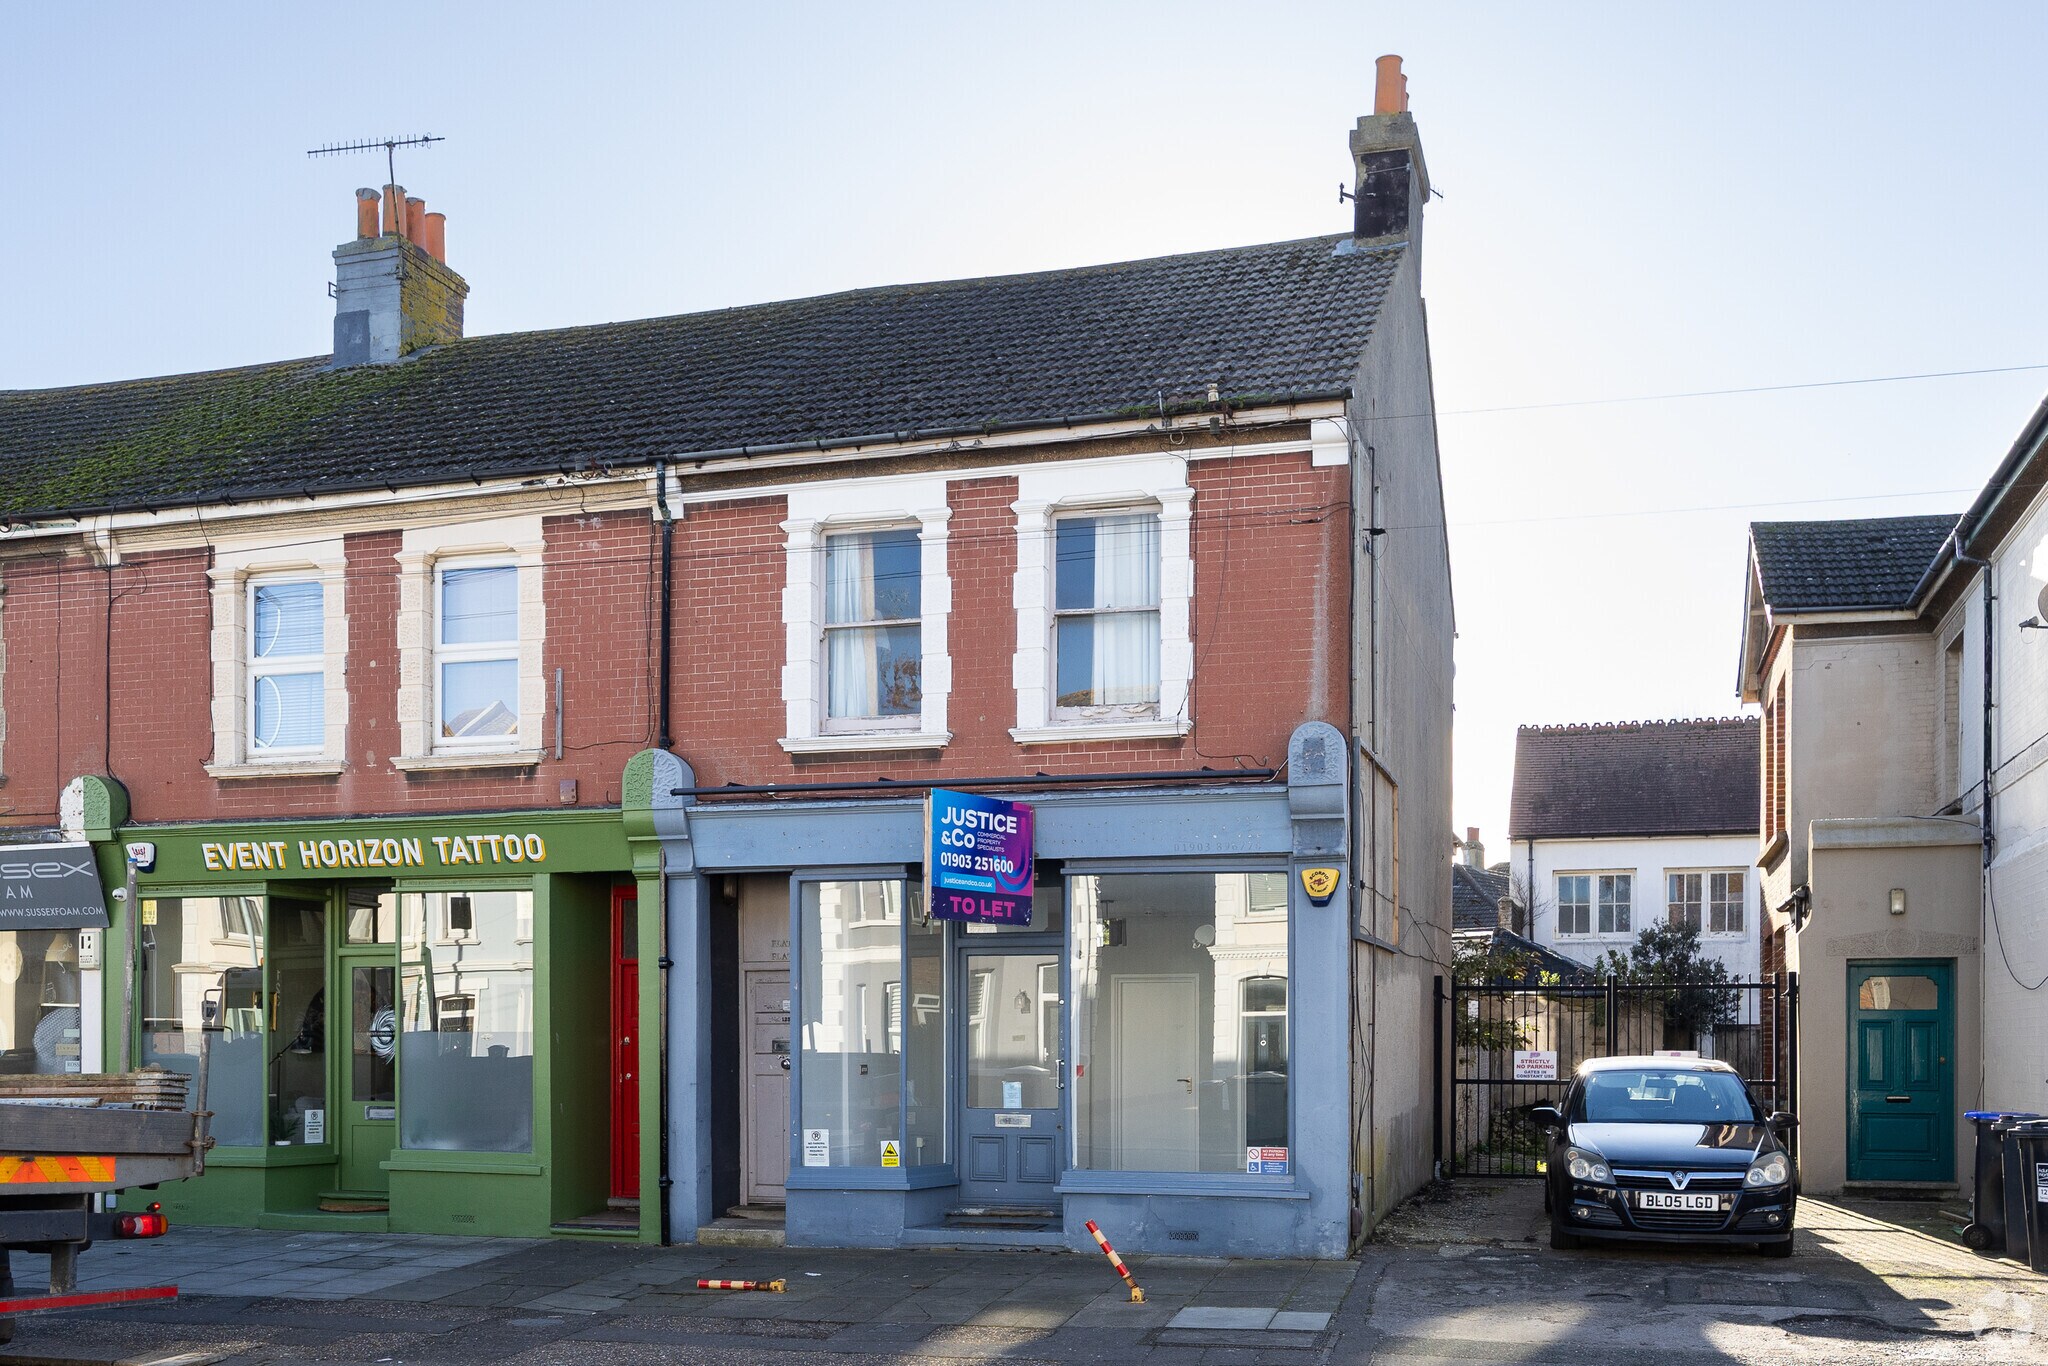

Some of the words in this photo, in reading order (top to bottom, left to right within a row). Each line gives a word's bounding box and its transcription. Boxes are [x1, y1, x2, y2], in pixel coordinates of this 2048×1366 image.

[941, 806, 1018, 834] JUSTICE
[941, 828, 976, 849] &Co
[977, 831, 1007, 841] COMMERCIAL
[977, 837, 1002, 846] PROPERTY
[201, 841, 287, 871] EVENT
[298, 837, 424, 869] HORIZON
[432, 833, 546, 865] TATTOO
[976, 844, 1006, 853] SPECIALISTS
[941, 852, 972, 869] 01903
[974, 856, 1014, 874] 251600
[944, 877, 993, 888] justiceandco.co.uk
[949, 896, 976, 915] TO
[980, 899, 1015, 917] LET
[1646, 1194, 1683, 1208] BL05
[1685, 1195, 1713, 1209] LGD
